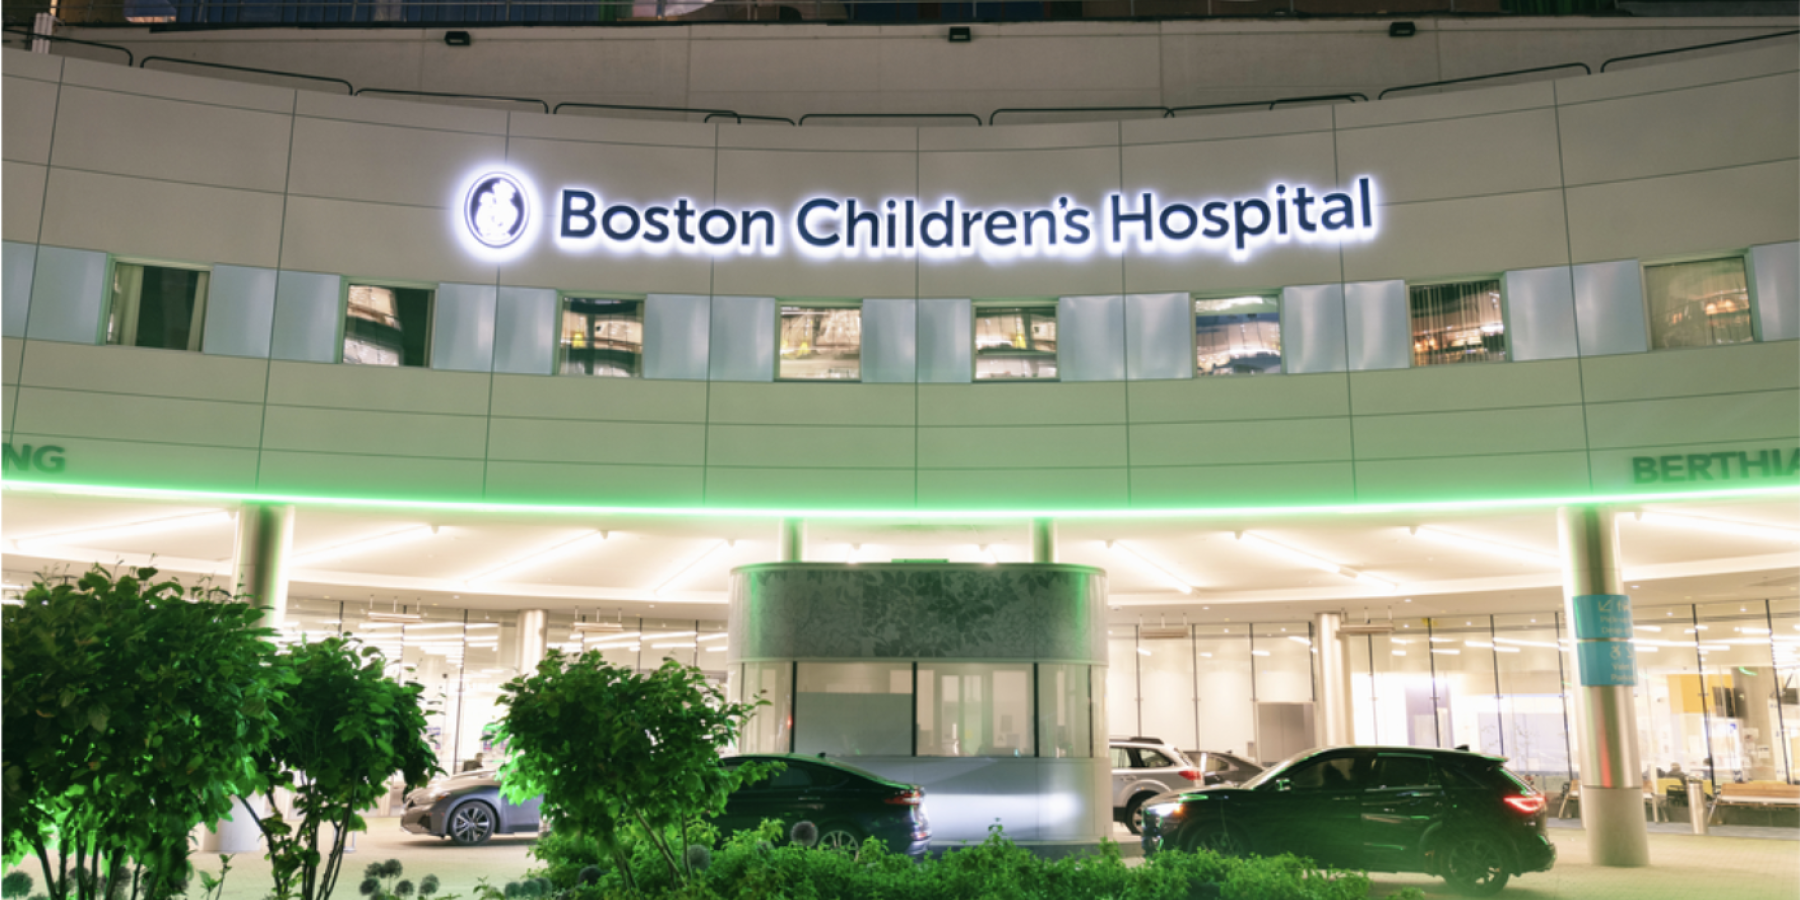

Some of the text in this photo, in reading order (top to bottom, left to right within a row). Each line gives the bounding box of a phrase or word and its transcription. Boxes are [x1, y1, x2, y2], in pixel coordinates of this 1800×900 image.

[559, 177, 1373, 250] Boston Children's Hospital
